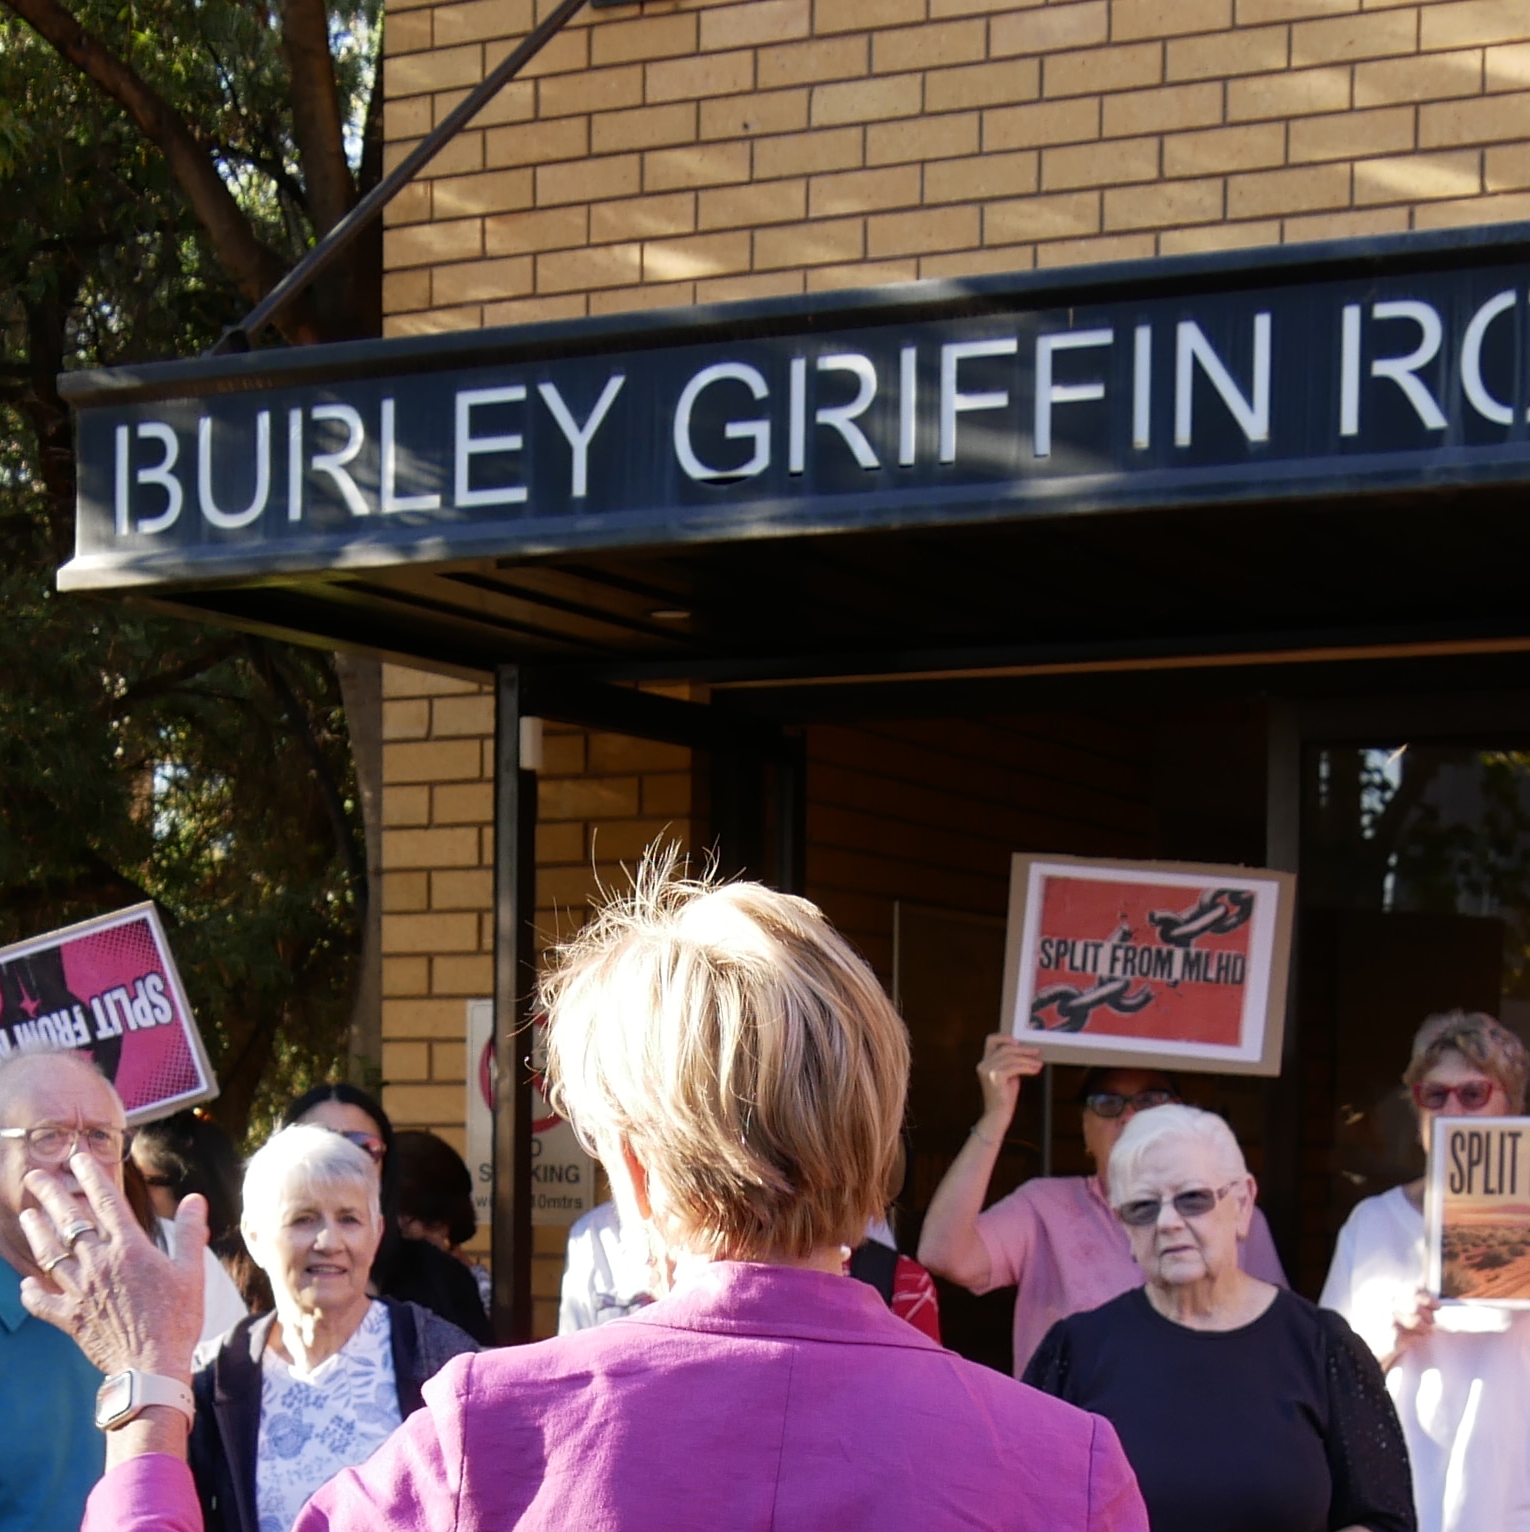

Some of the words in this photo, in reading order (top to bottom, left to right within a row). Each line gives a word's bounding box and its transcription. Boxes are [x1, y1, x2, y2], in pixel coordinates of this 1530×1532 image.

[114, 374, 626, 537] BURLEY
[672, 312, 1271, 482] GRIFFIN
[1038, 938, 1104, 973] SPLIT
[1109, 943, 1174, 980] FROM
[1181, 951, 1248, 985] MLHD
[90, 971, 174, 1041] SPLIT
[479, 1163, 581, 1184] SKING
[1449, 1130, 1523, 1195] SPLIT
